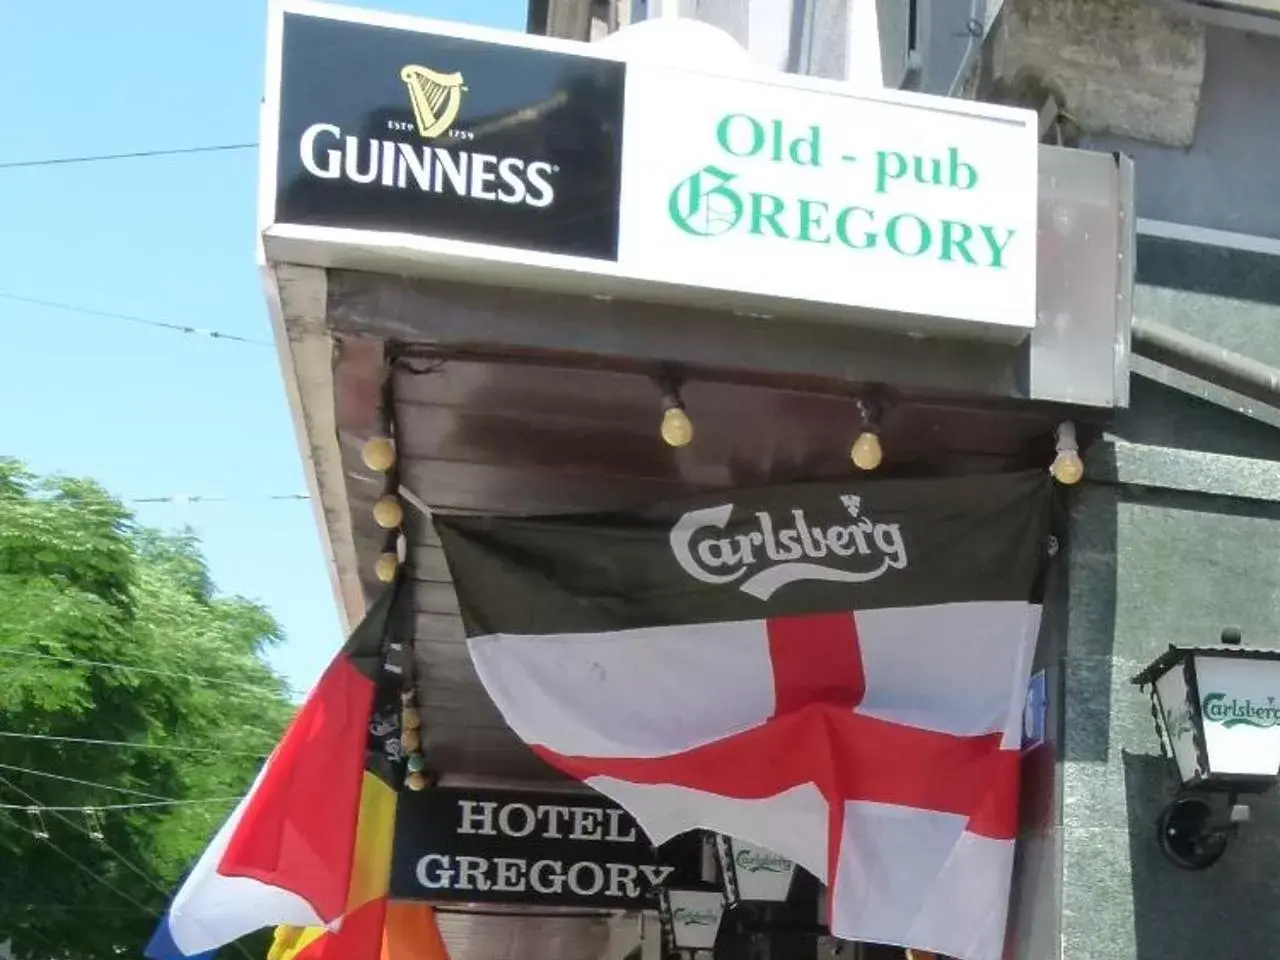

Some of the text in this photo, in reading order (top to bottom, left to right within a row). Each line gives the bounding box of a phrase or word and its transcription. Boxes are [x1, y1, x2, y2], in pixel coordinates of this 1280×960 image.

[299, 123, 555, 208] GUINNESS
[716, 112, 822, 168] Old
[874, 146, 979, 194] pub
[668, 164, 1017, 271] GREGORY
[669, 496, 908, 600] Carlsberg
[457, 800, 637, 843] HOTEL
[415, 854, 674, 898] GREGORY
